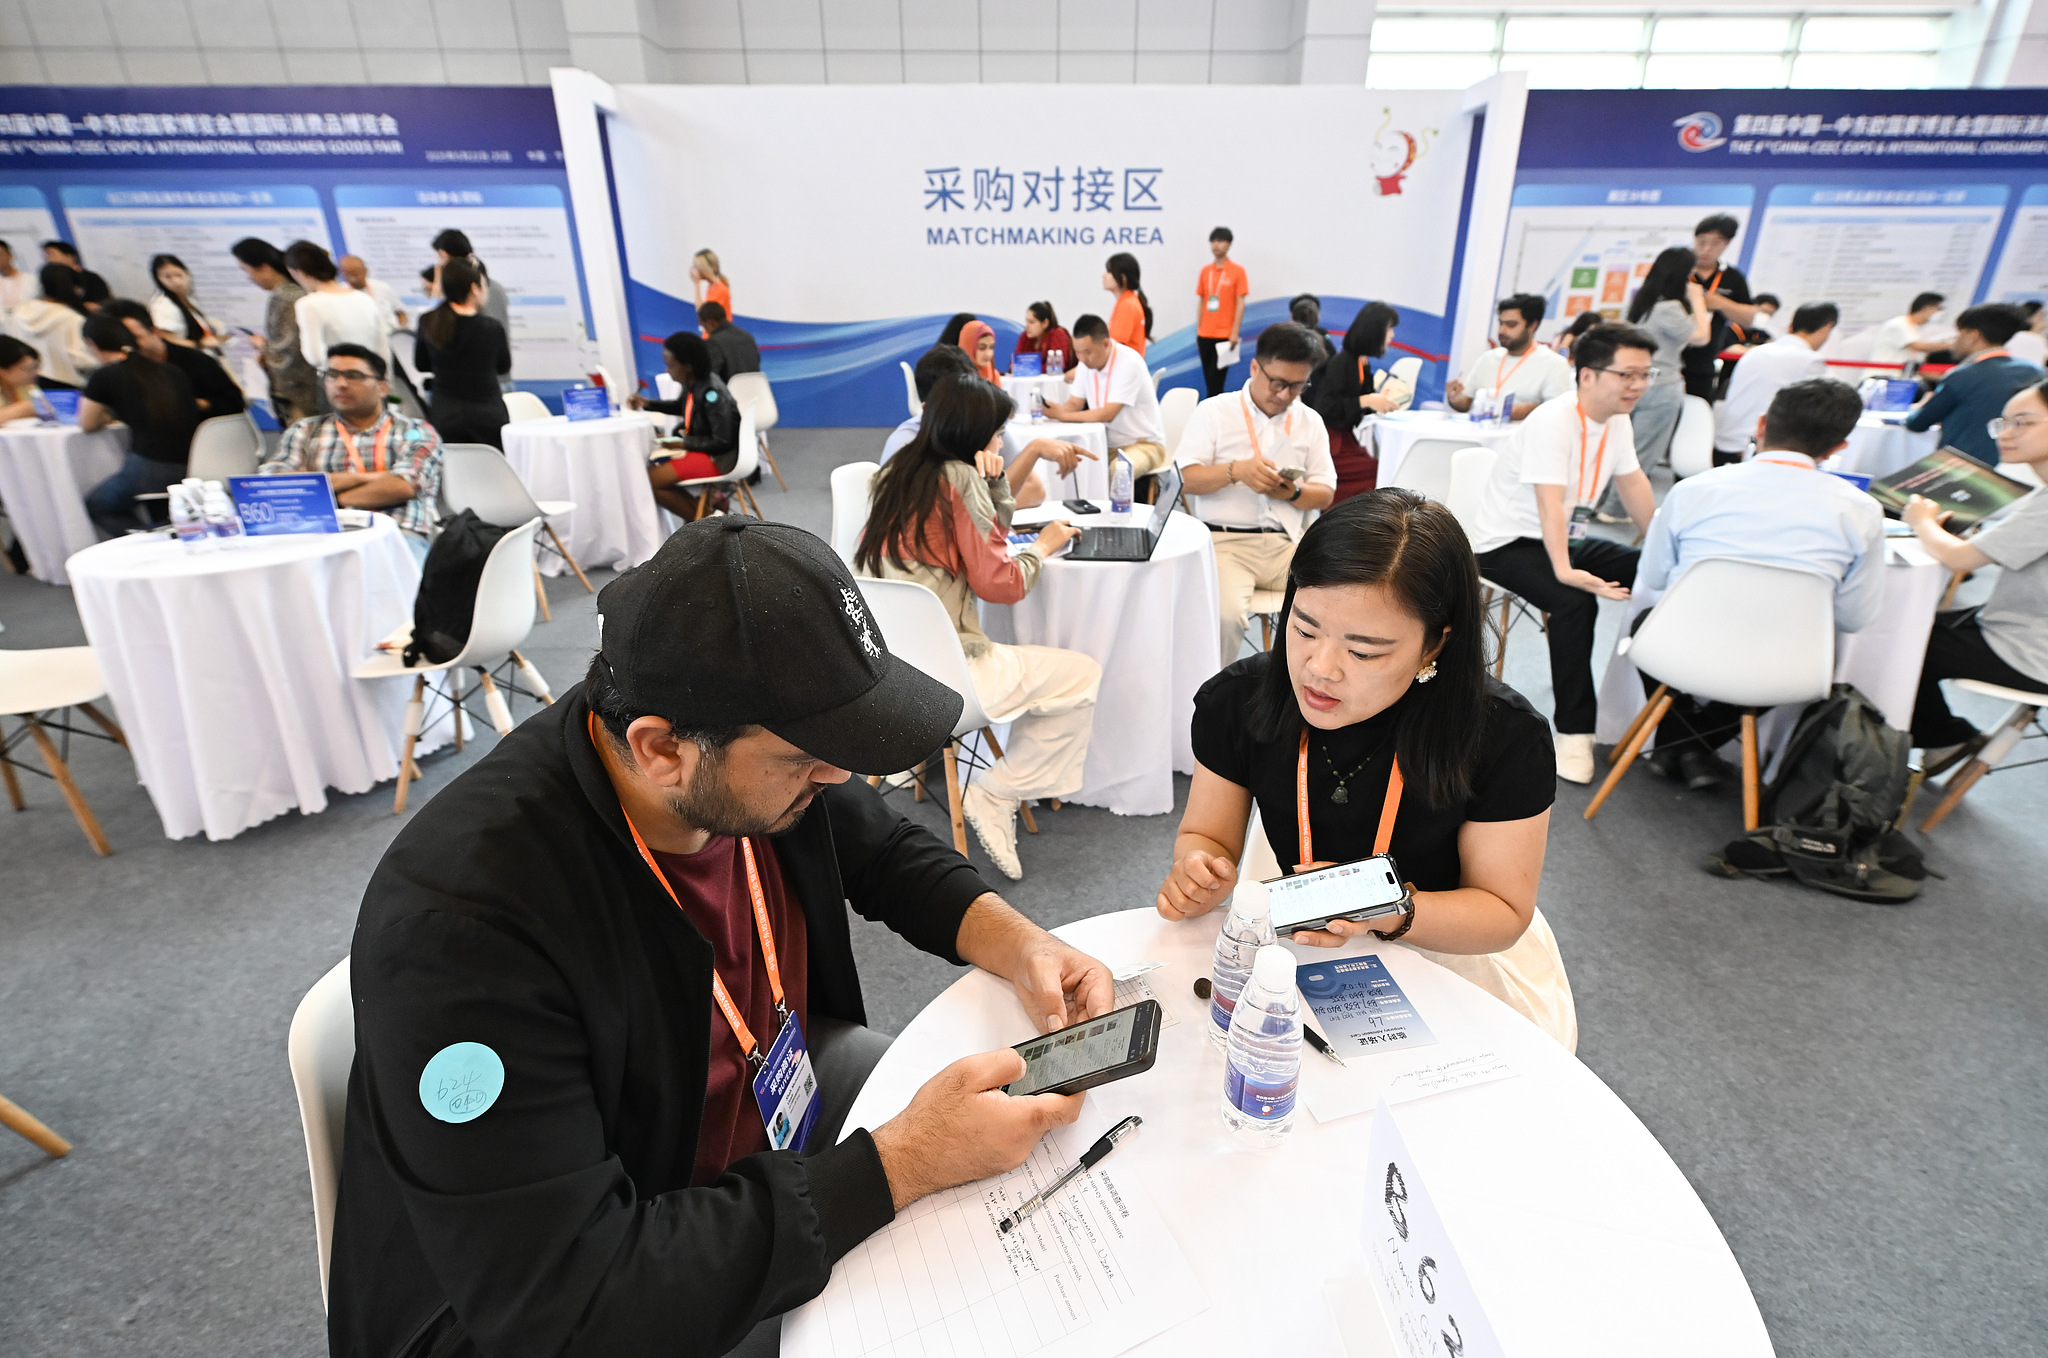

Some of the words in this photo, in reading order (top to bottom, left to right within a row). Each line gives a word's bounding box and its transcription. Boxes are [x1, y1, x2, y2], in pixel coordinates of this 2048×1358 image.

[327, 139, 374, 155] GOODS
[373, 139, 405, 155] FAIR
[924, 167, 1163, 212] 采购对接区
[927, 227, 1095, 245] MATCHMAKING
[1102, 227, 1164, 245] AREA
[721, 999, 735, 1019] GOODS
[730, 1015, 741, 1030] FAIR
[1357, 1031, 1407, 1046] 临时入场证
[770, 1047, 794, 1096] 采购商证
[778, 1067, 793, 1096] BUYER
[1097, 1168, 1130, 1219] 采购商调查问卷
[1026, 1214, 1039, 1233] Product
[1045, 1208, 1057, 1223] meet
[1088, 1179, 1103, 1199] survey
[1098, 1198, 1125, 1239] questionnaire
[1048, 1221, 1061, 1236] your
[1054, 1234, 1076, 1265] purchasing
[1070, 1263, 1085, 1283] needs.
[1052, 1273, 1069, 1299] Purchase
[1064, 1298, 1078, 1321] amount
